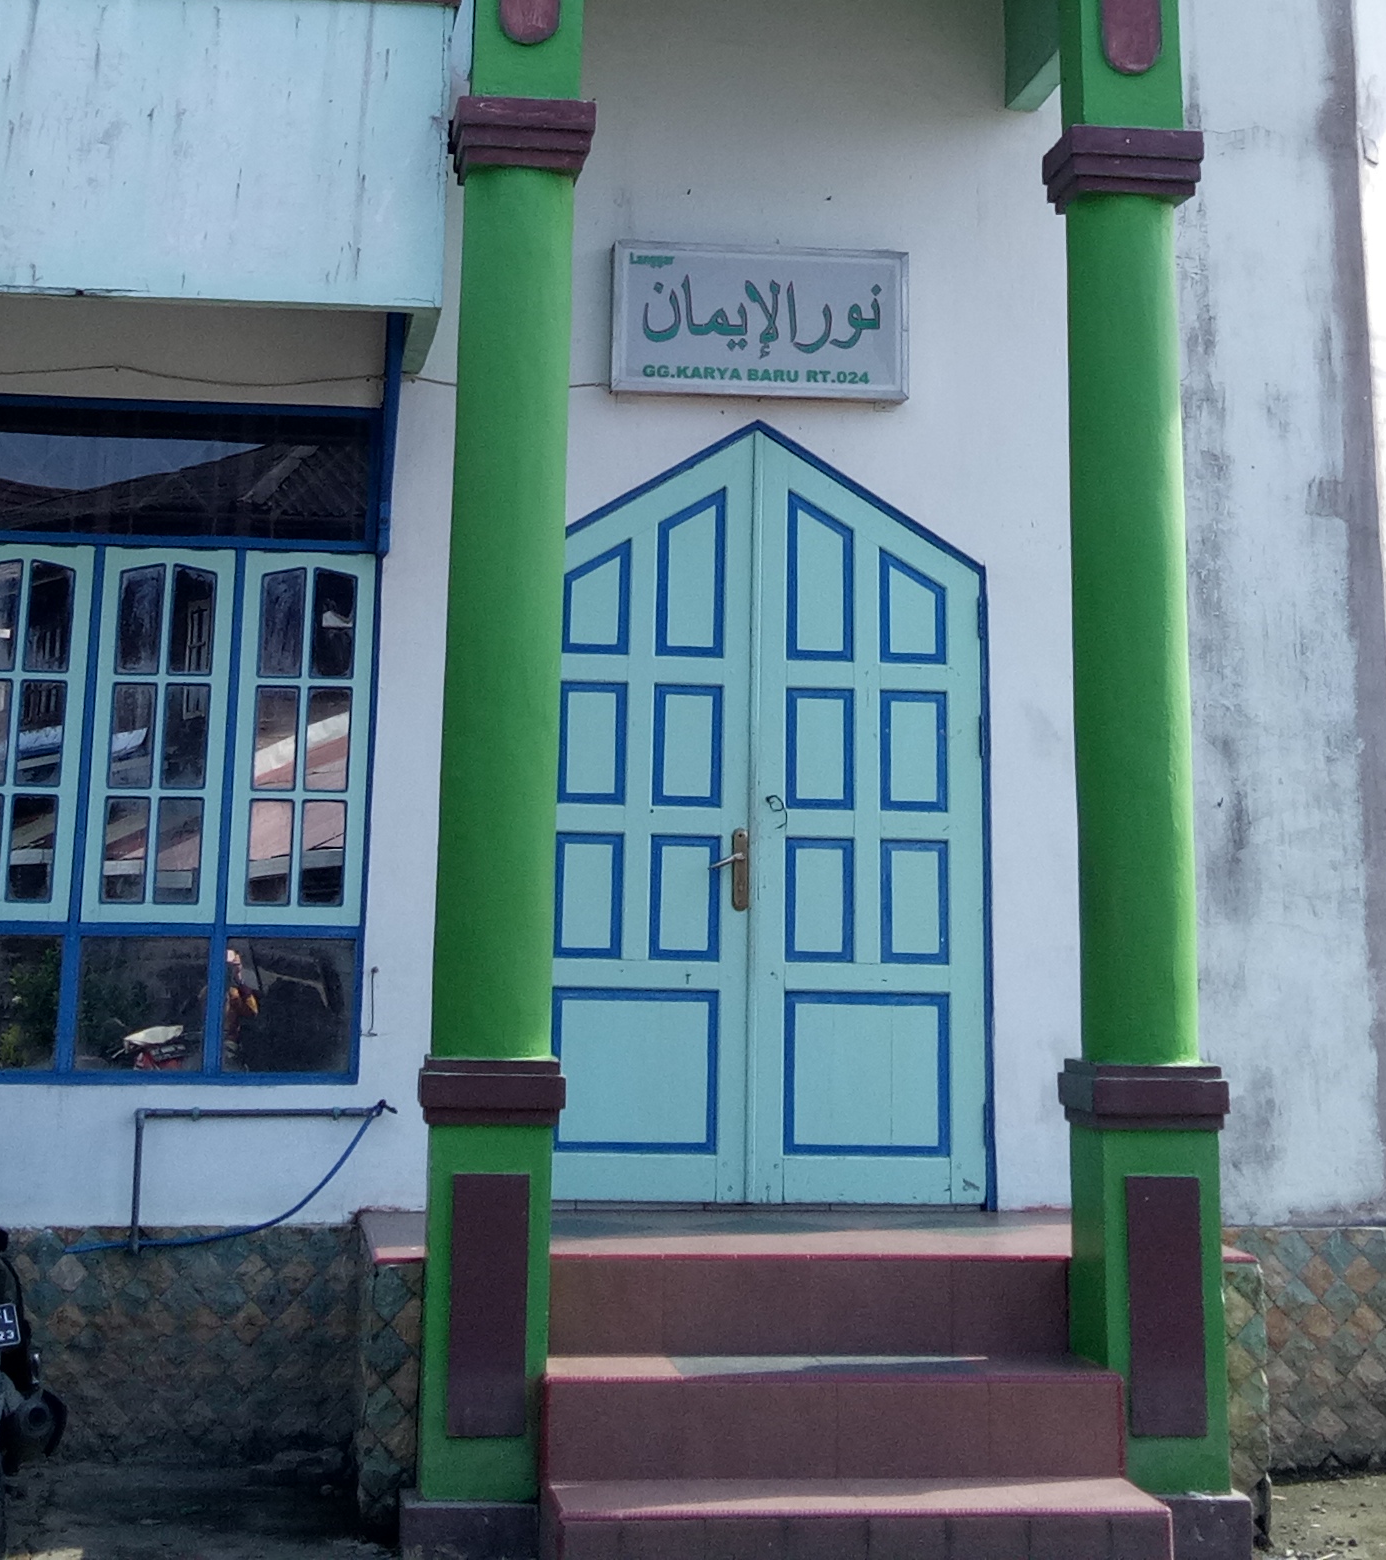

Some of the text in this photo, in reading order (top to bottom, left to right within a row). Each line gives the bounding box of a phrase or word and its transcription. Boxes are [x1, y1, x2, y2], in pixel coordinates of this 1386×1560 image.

[629, 252, 675, 269] Langgar
[642, 364, 870, 385] GG.KARYA BARU RT.024
